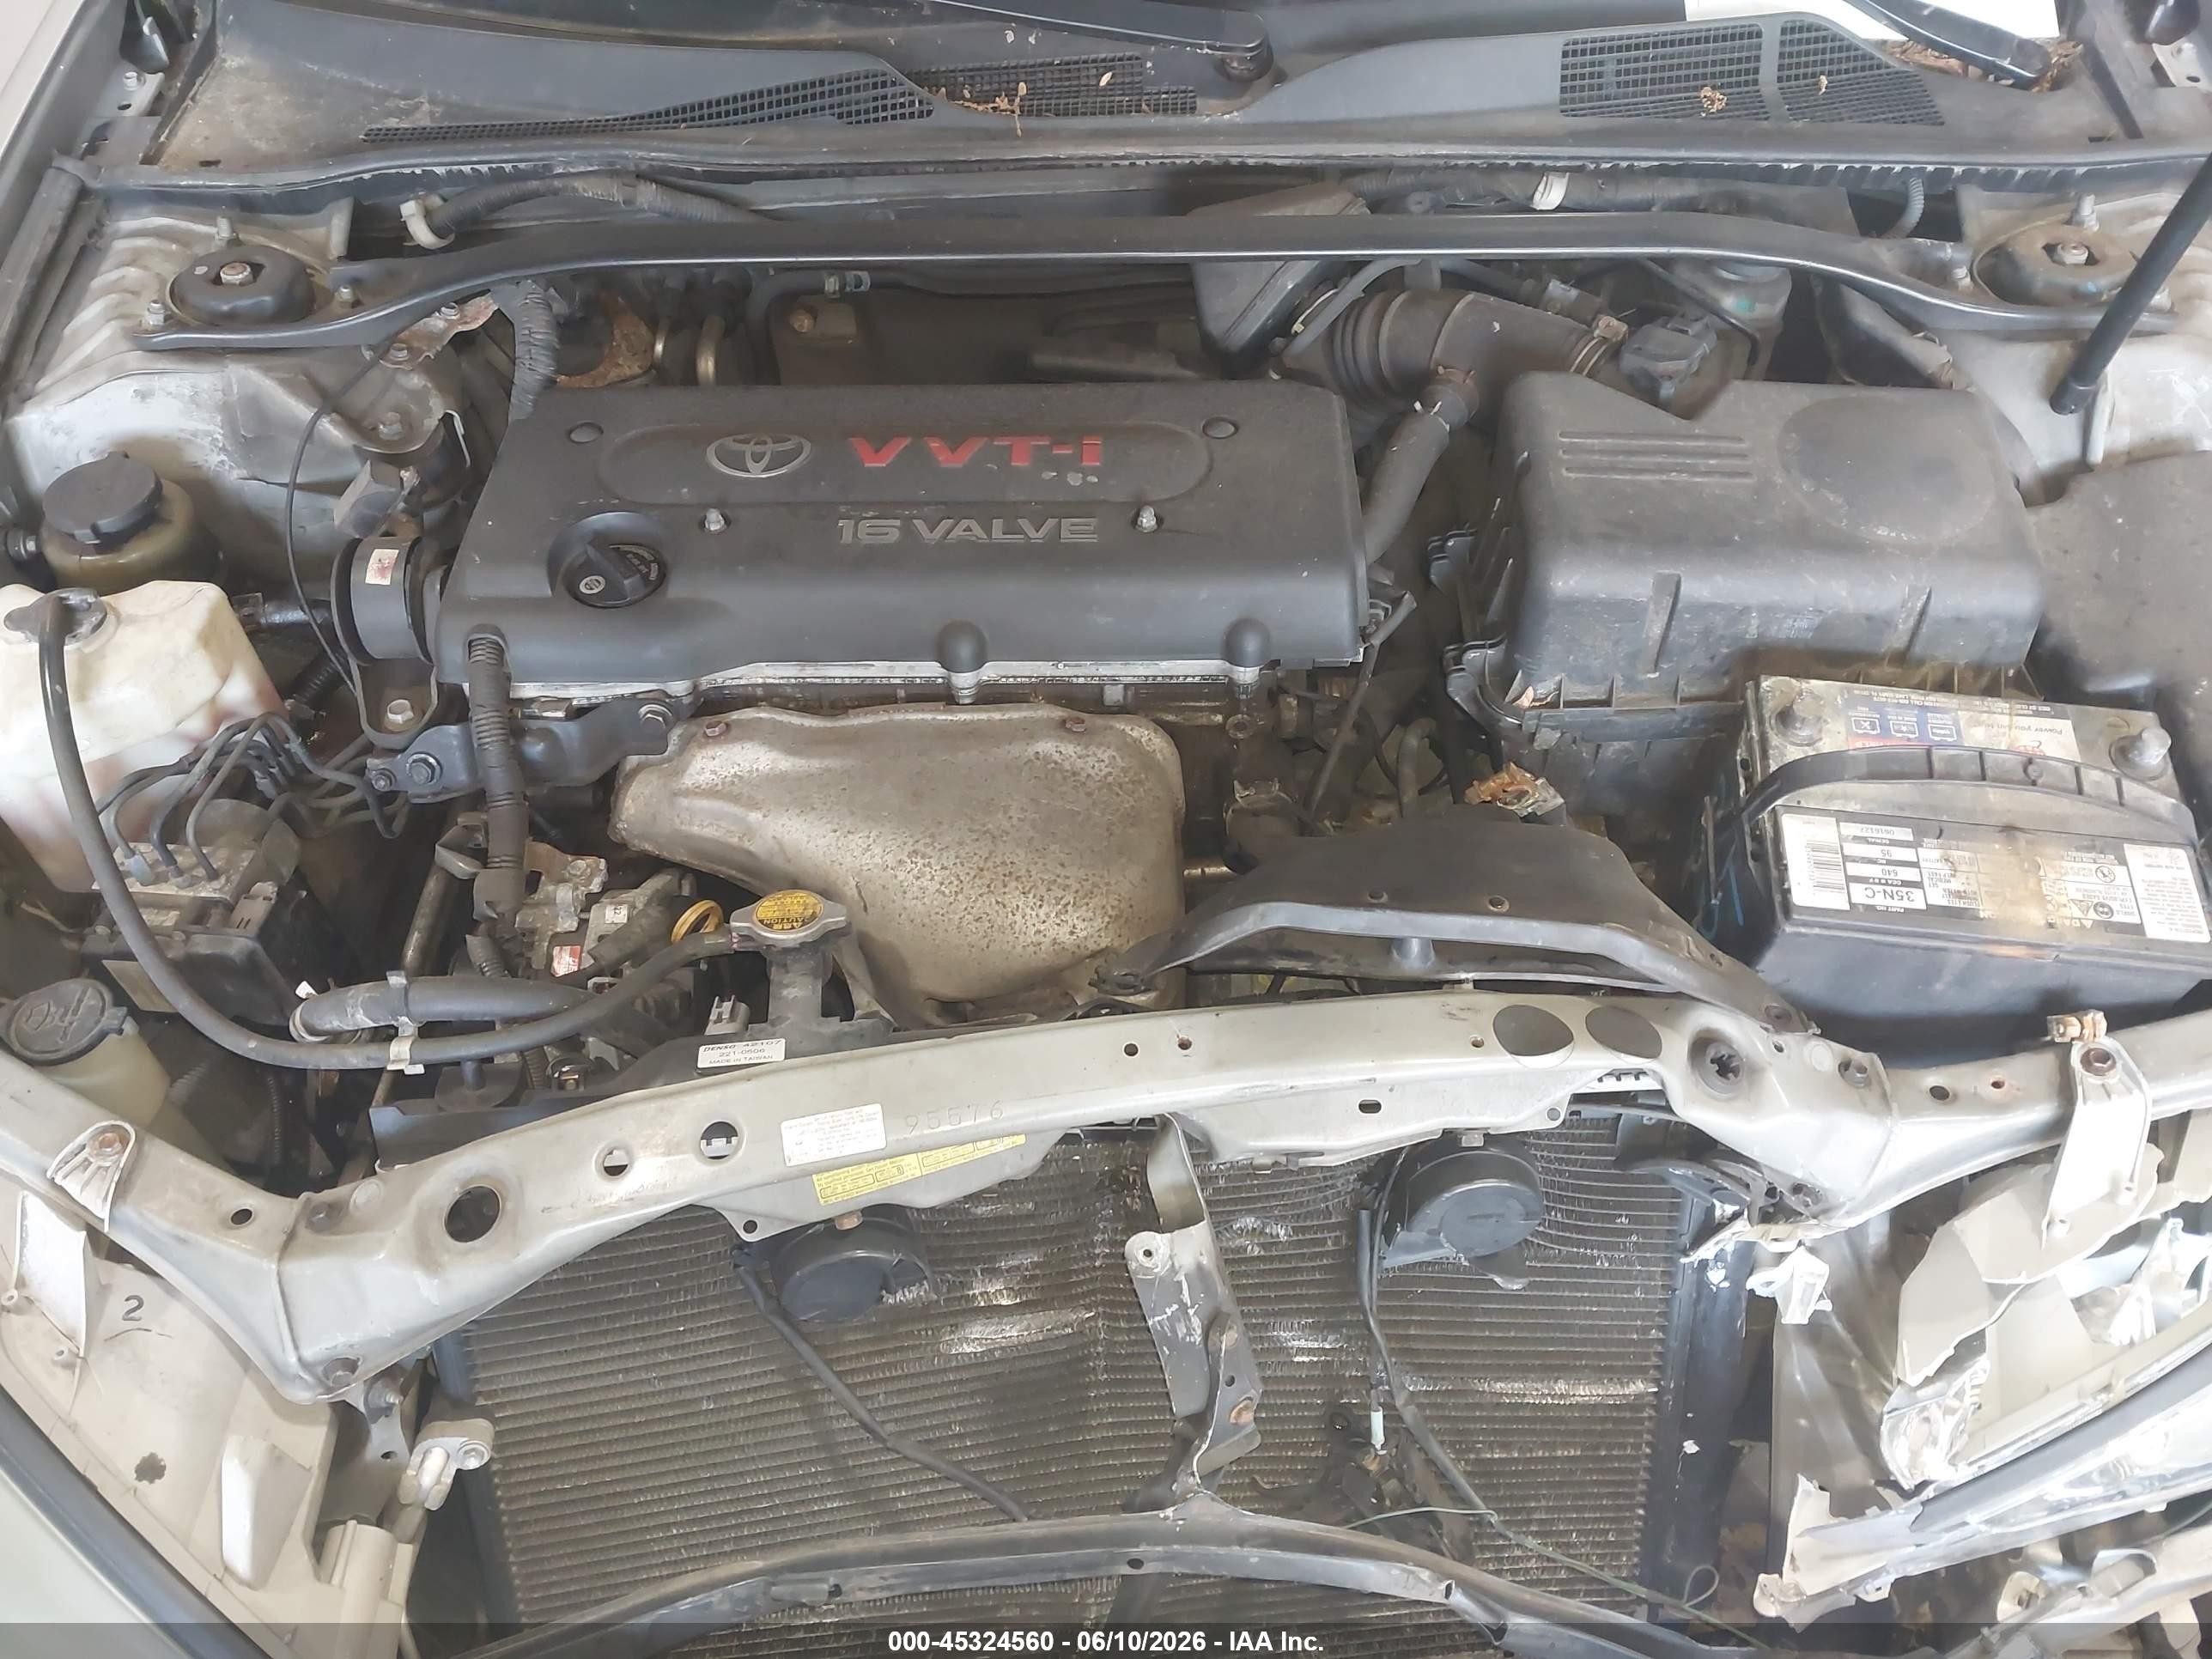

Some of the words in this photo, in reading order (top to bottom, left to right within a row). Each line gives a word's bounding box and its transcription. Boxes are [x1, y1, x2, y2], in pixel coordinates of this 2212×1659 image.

[837, 518, 902, 544] 16
[912, 518, 1100, 544] VALVE
[2033, 727, 2063, 736] Power
[1881, 868, 1899, 877] 640
[1864, 886, 1916, 903] 35N-C
[702, 1044, 737, 1053] DENSO
[744, 1054, 774, 1063] TAIWAN
[122, 1294, 144, 1322] 2
